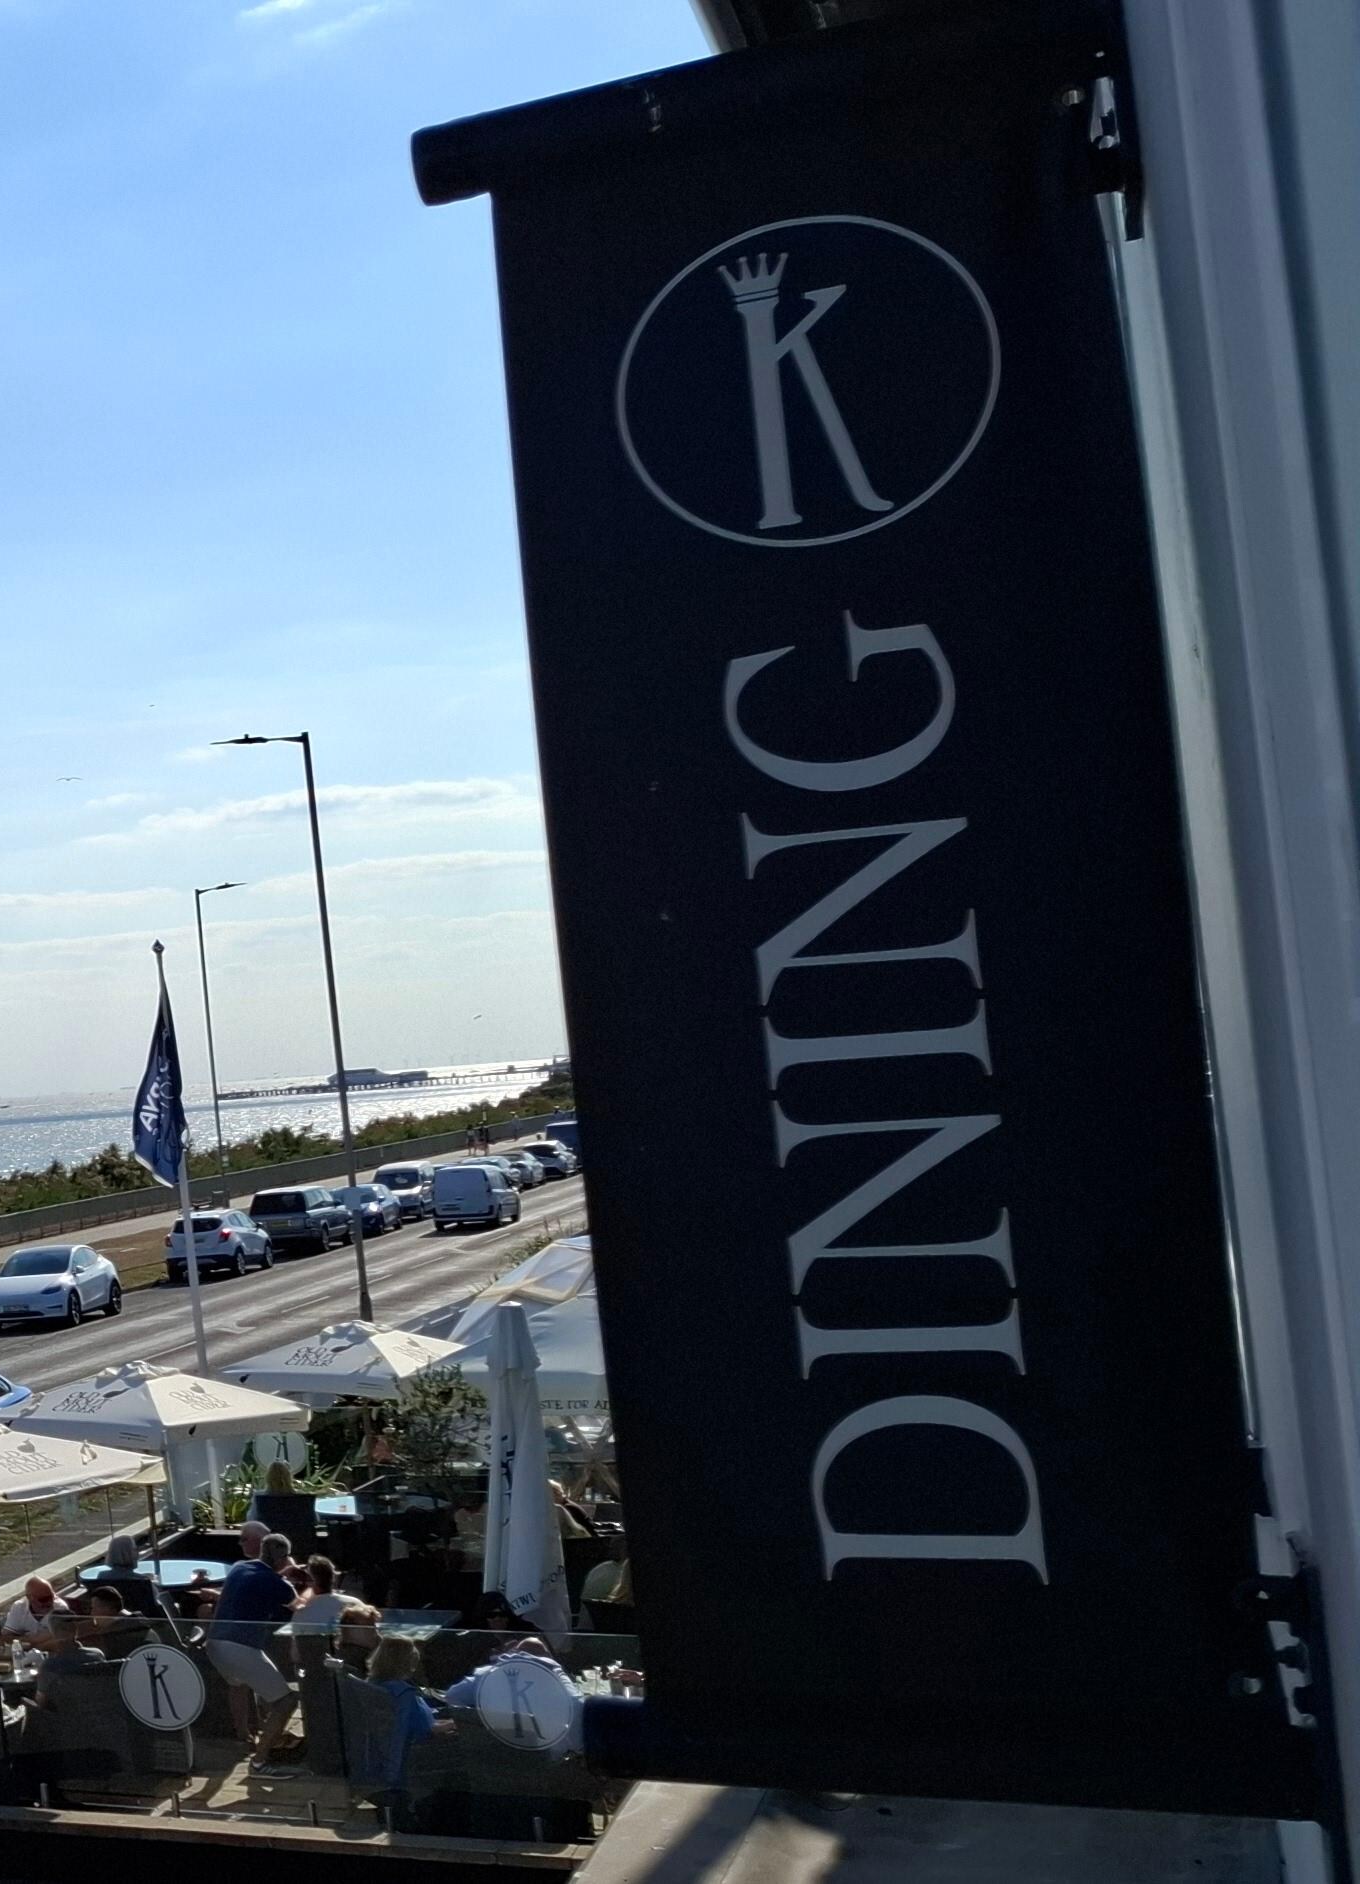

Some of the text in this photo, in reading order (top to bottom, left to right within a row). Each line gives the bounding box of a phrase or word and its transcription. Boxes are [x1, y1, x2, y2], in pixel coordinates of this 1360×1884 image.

[736, 284, 895, 529] K
[721, 609, 1048, 1585] DINING
[147, 1663, 182, 1721] K
[507, 1679, 547, 1741] K
